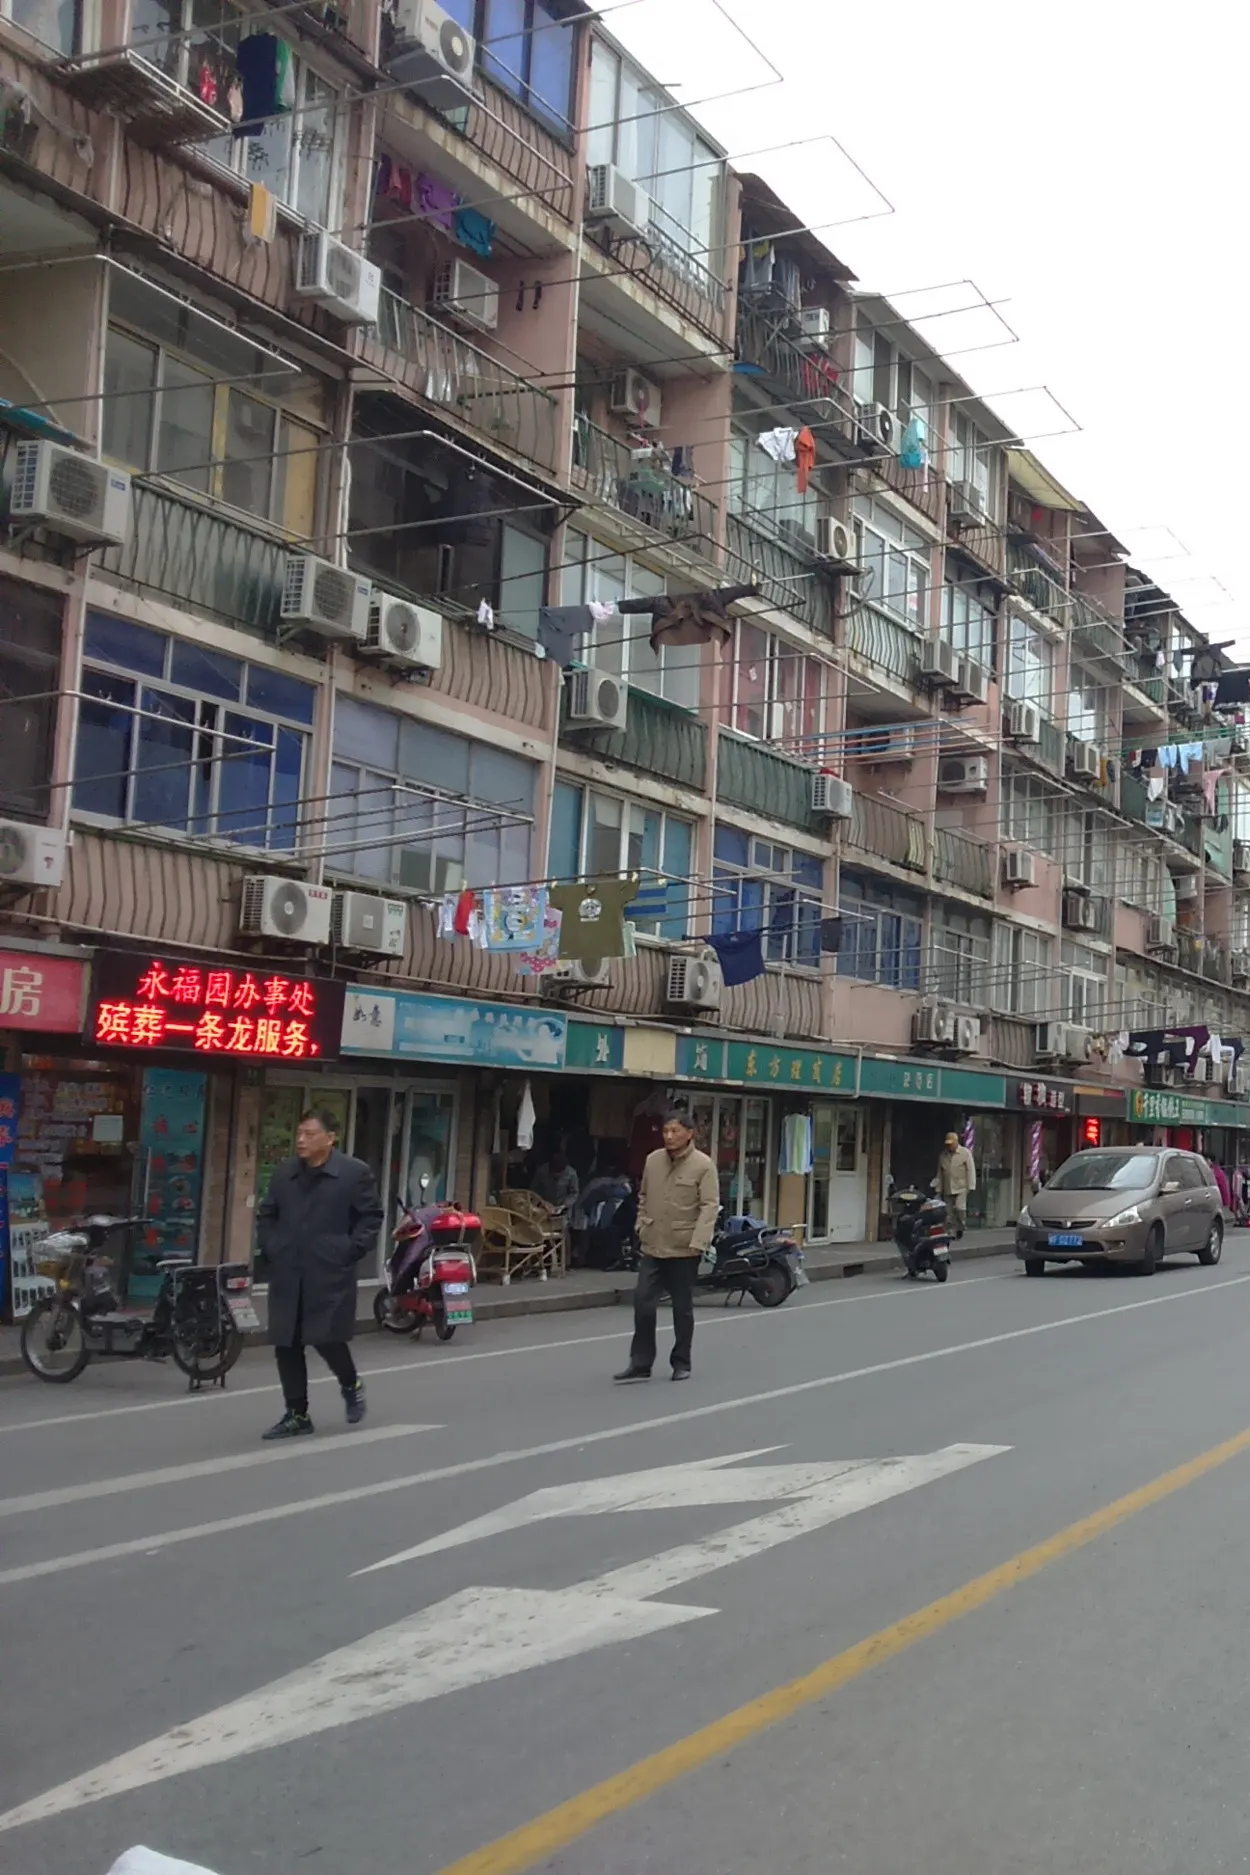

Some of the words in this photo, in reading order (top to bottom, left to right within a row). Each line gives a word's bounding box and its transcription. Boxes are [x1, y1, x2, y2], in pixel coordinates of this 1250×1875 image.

[0, 966, 44, 1016] 房
[136, 961, 315, 1016] 永福园办事处
